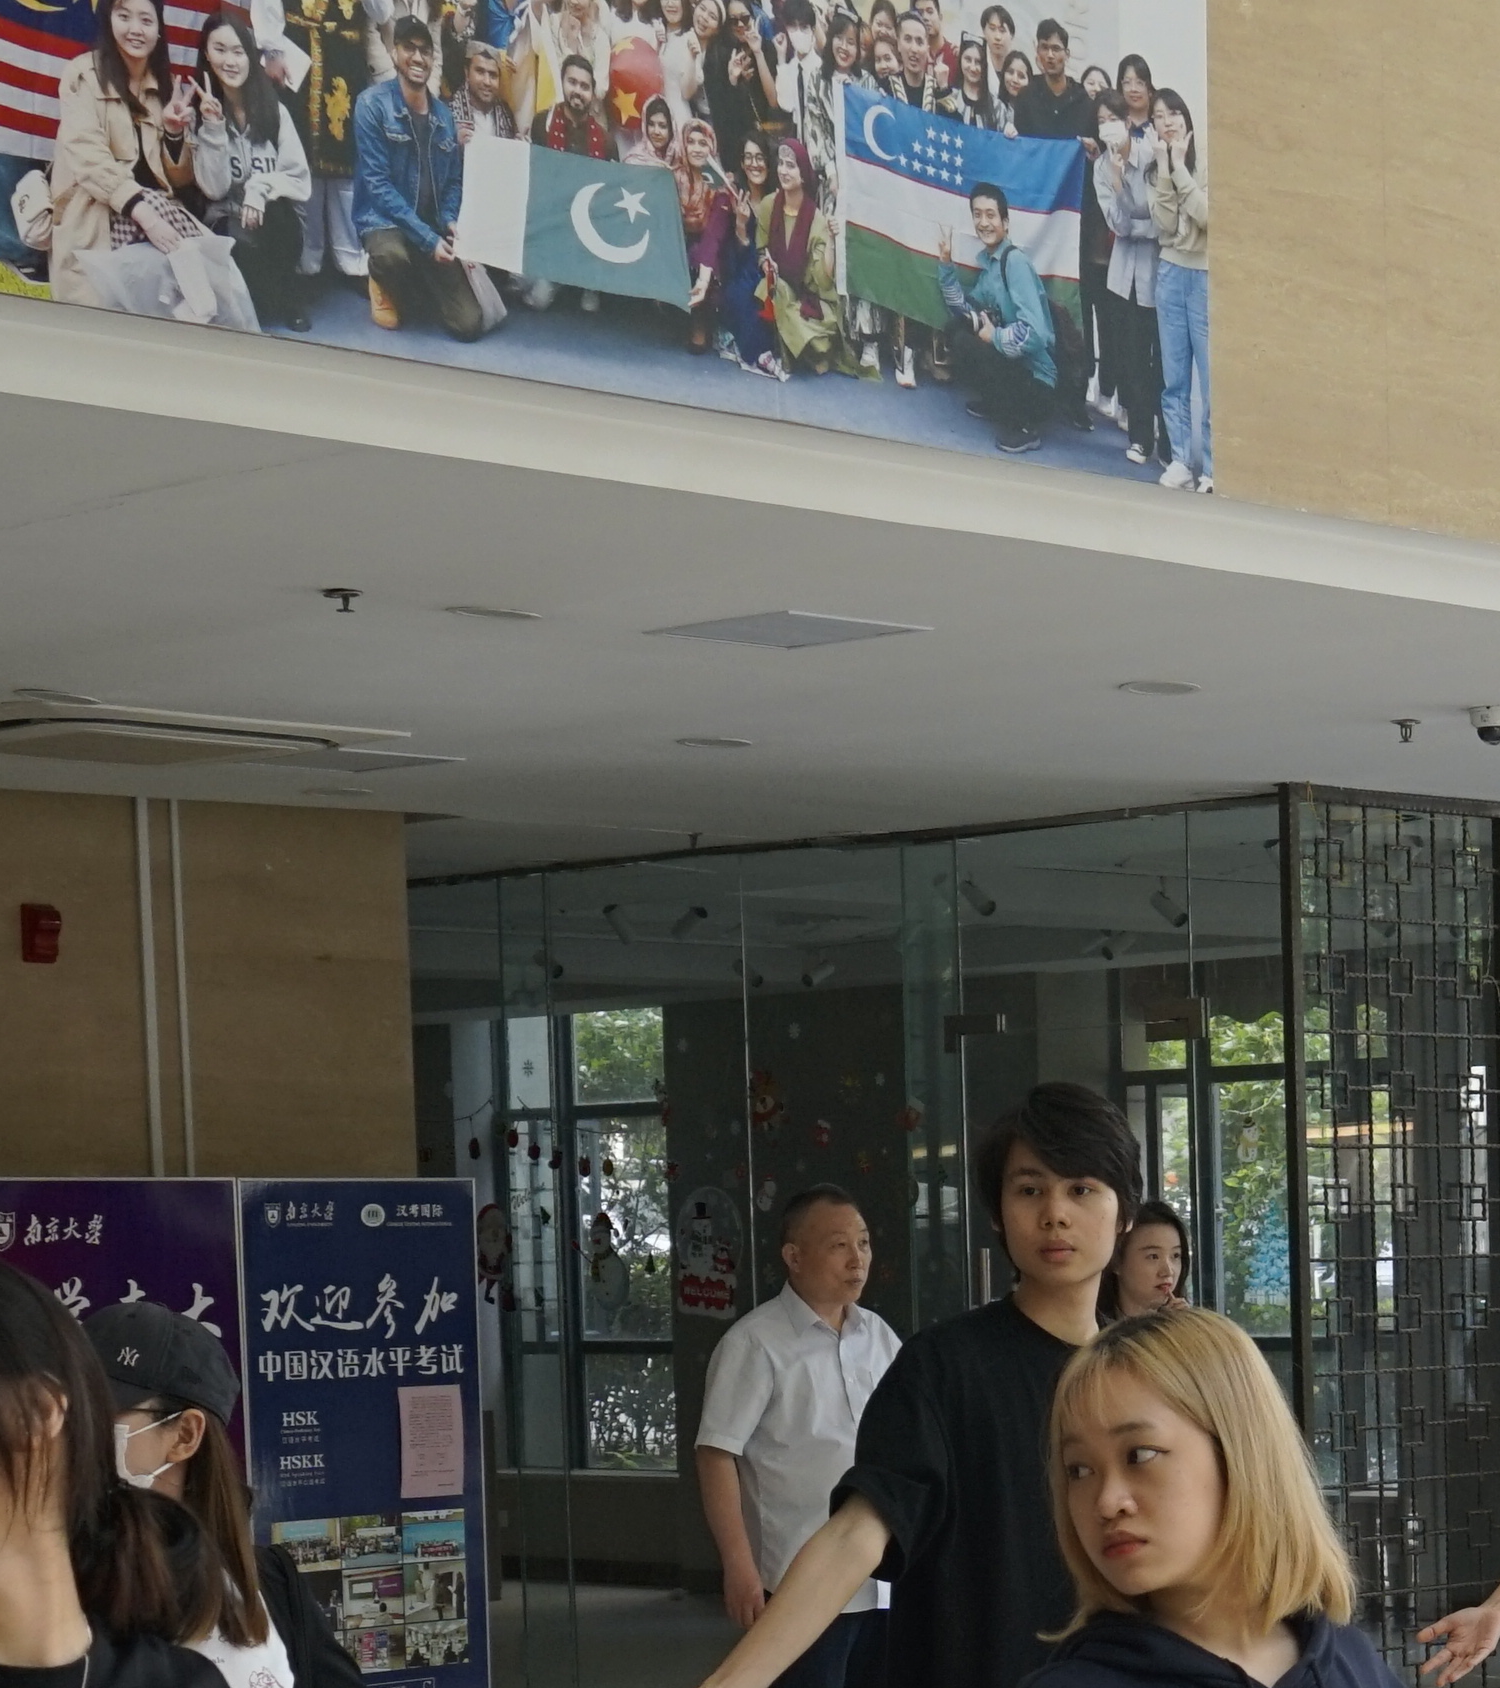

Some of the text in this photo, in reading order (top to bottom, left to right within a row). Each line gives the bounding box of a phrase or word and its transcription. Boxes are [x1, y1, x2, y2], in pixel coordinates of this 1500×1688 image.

[396, 1203, 444, 1218] 汉考国际
[260, 1273, 458, 1339] 欢迎参加
[258, 1344, 465, 1383] 中国汉语水平考试
[282, 1410, 320, 1427] HSK
[279, 1453, 325, 1470] HSKK
